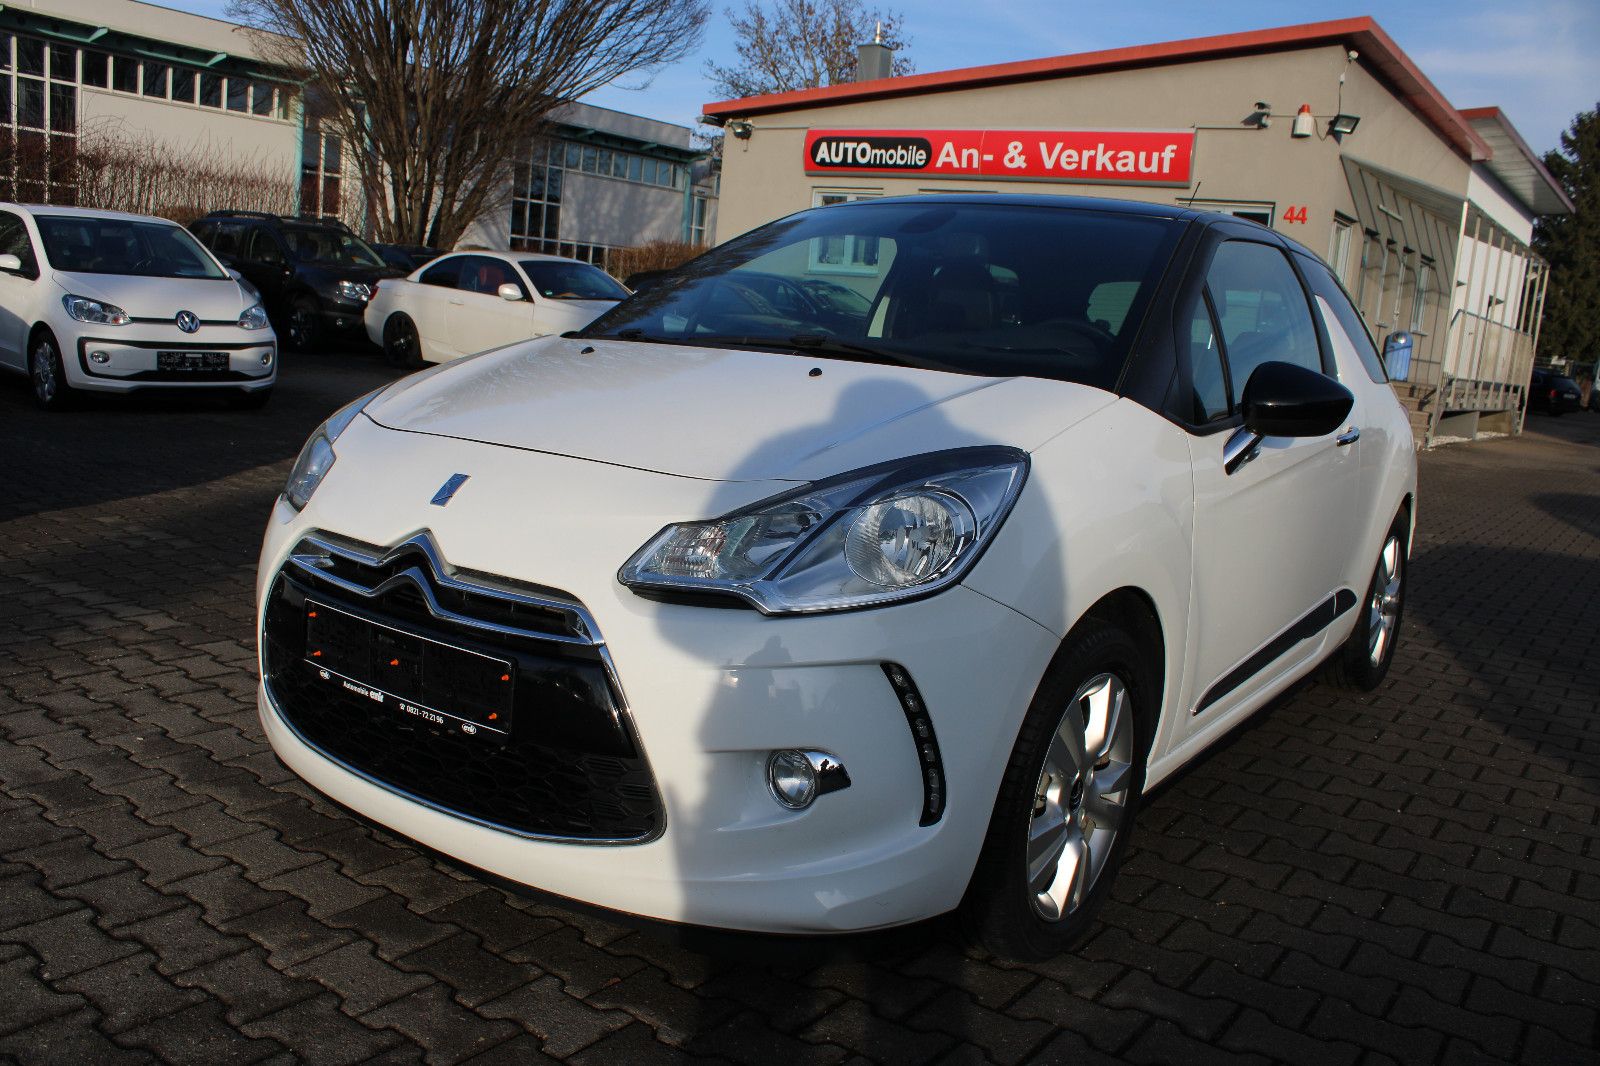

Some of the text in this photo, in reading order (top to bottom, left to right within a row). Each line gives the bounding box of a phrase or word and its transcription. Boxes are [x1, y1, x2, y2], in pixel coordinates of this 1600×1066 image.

[815, 140, 1178, 174] AUTOmobile An- & Verkauf
[1283, 205, 1308, 225] 44
